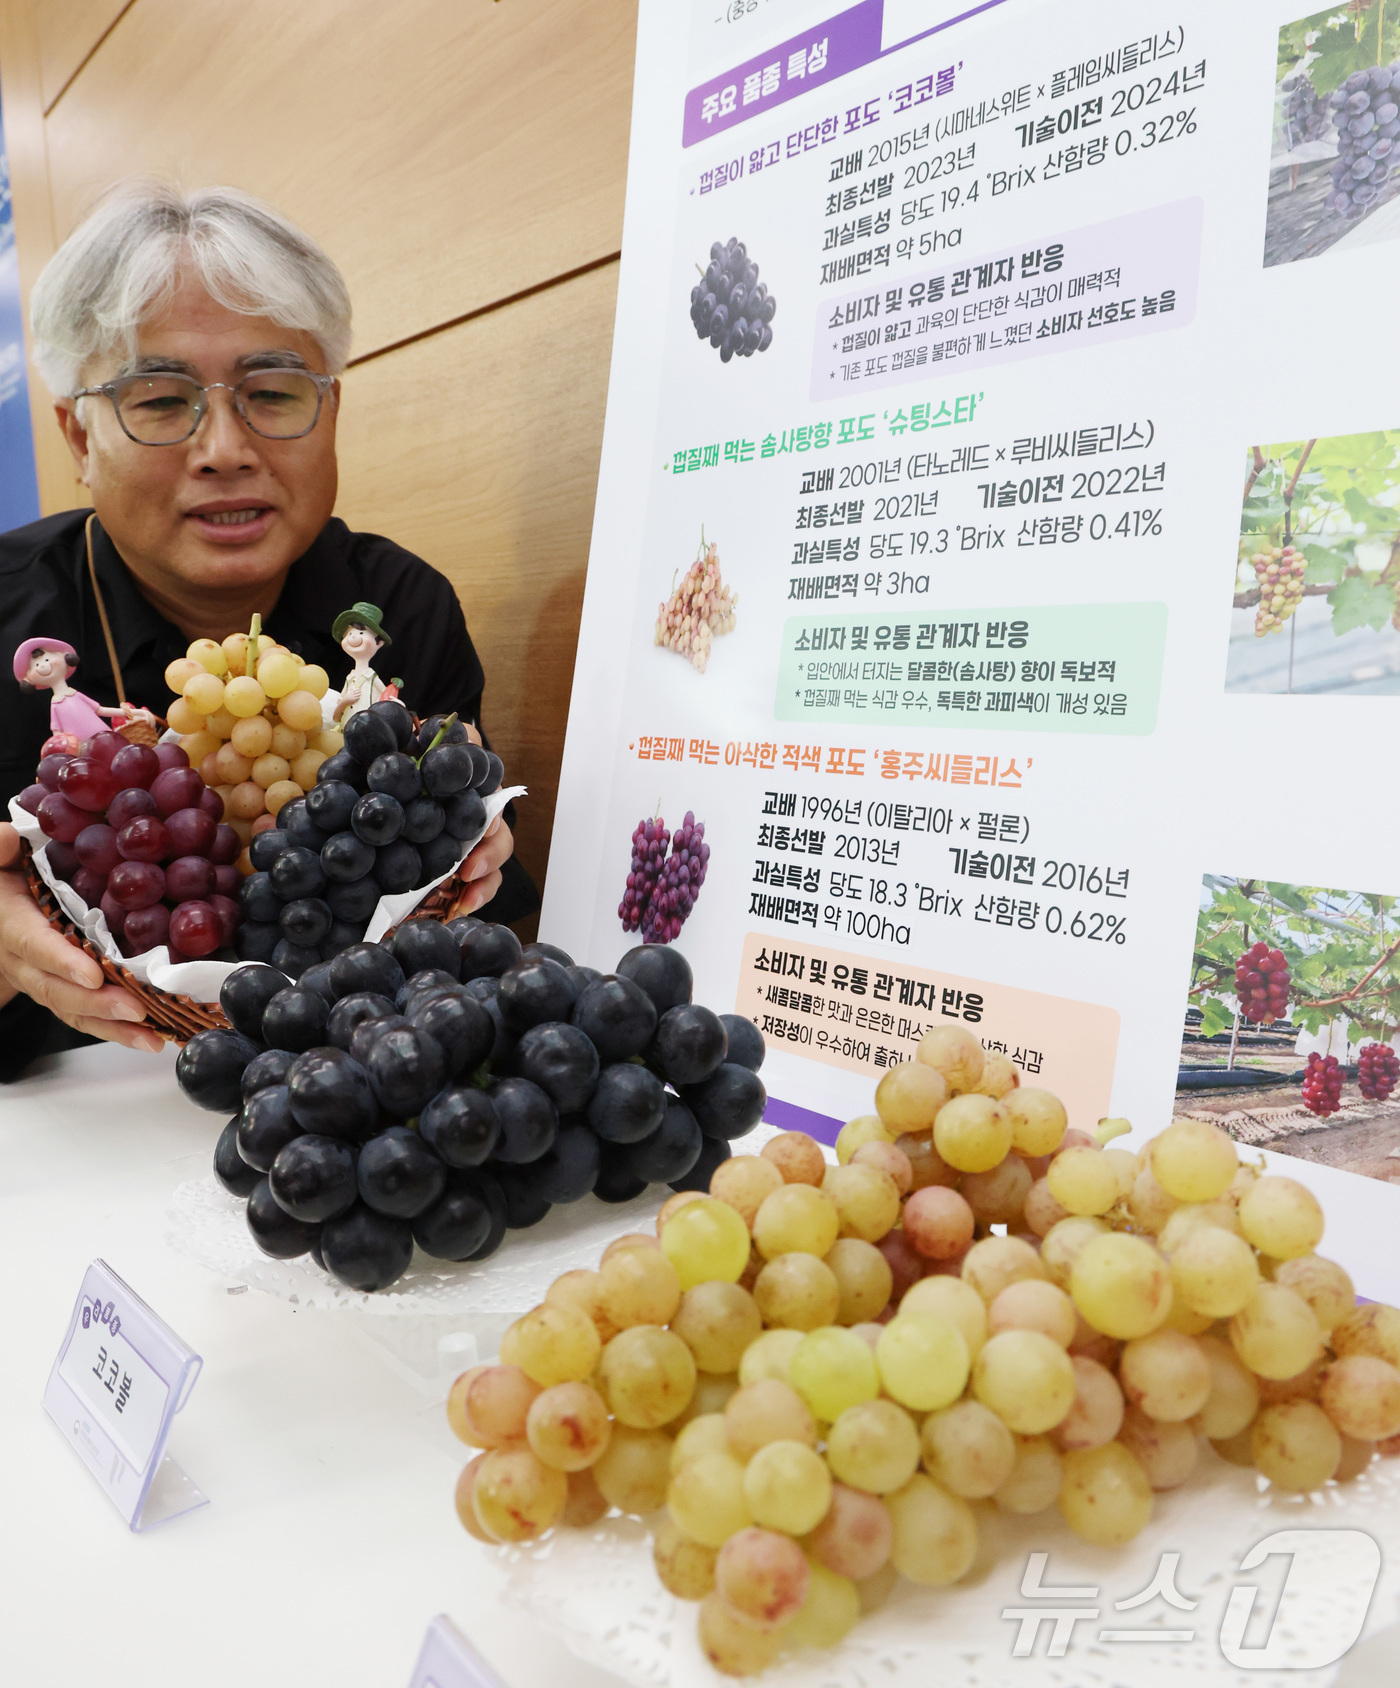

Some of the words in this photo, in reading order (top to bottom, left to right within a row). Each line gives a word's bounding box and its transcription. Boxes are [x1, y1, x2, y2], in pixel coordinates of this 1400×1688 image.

[700, 85, 738, 124] 주요
[742, 61, 781, 106] 품종
[786, 36, 830, 81] 특성
[827, 148, 864, 184] 교배
[867, 122, 931, 168] 2015년
[934, 83, 1032, 143] (시마네스위트
[1050, 24, 1185, 100] 플레임씨들리스)
[699, 155, 745, 196] 껍질이
[748, 140, 781, 175] 얇고
[785, 114, 840, 160] 단단한
[842, 96, 881, 136] 포도
[824, 171, 895, 218] 최종선발
[903, 141, 976, 190] 2023년
[1014, 95, 1104, 149] 기술이전
[1109, 58, 1207, 118] 2024년
[821, 207, 892, 252] 과실특성
[900, 193, 935, 227] 당도
[940, 179, 980, 213] 19.4
[1042, 135, 1110, 181] 산함량
[1114, 106, 1198, 157] 0.32%
[819, 242, 892, 286] 재배면적
[895, 236, 915, 261] 약
[918, 227, 963, 257] 5ha
[827, 293, 881, 330] 소비자
[884, 286, 904, 315] 및
[907, 275, 946, 309] 유통
[950, 255, 1016, 298] 관계자
[1020, 243, 1065, 280] 반응
[839, 361, 862, 382] 기존
[863, 354, 888, 378] 포도
[891, 345, 929, 372] 껍질을
[931, 331, 987, 363] 불편하게
[988, 321, 1033, 350] 느꼈던
[1035, 309, 1084, 340] 소비자
[1086, 297, 1137, 329] 선호도
[1140, 289, 1177, 318] 높음
[841, 326, 882, 354] 껍질이
[883, 319, 912, 344] 얇고
[914, 307, 959, 336] 과육의
[962, 294, 1011, 325] 단단한
[1013, 280, 1064, 310] 식감이
[1067, 266, 1122, 300] 매력적
[672, 442, 721, 475] 껍질째
[723, 438, 756, 464] 먹는
[760, 421, 834, 459] 솜사탕향
[836, 413, 876, 445] 포도
[798, 467, 836, 496] 교배
[837, 456, 902, 490] 2001년
[906, 443, 991, 481] (타노레드
[1010, 418, 1155, 466] 루비씨들리스)
[794, 498, 866, 530] 최종선발
[872, 489, 939, 522] 2021년
[976, 473, 1065, 510] 기술이전
[1070, 461, 1166, 500] 2022년
[790, 535, 861, 566] 과실특성
[869, 532, 905, 560] 당도
[909, 528, 950, 556] 19.3
[1016, 514, 1085, 548] 산함량
[1089, 507, 1163, 541] 0.41%
[786, 572, 860, 601] 재배면적
[863, 571, 883, 597] 약
[885, 570, 931, 596] 3ha
[793, 626, 847, 652] 소비자
[850, 625, 870, 651] 및
[872, 624, 912, 651] 유통
[915, 621, 981, 650] 관계자
[985, 620, 1030, 650] 반응
[806, 661, 860, 681] 입안에서
[861, 661, 904, 682] 터지는
[906, 659, 1017, 683] 달콤한(솜사탕)
[1020, 659, 1057, 683] 향이
[1059, 660, 1117, 683] 독보적
[803, 688, 842, 708] 껍질째
[843, 689, 869, 709] 먹는
[871, 689, 899, 710] 식감
[900, 690, 932, 713] 우수,
[936, 689, 983, 712] 독특한
[983, 690, 1051, 714] 과피색이
[1055, 692, 1089, 716] 개성
[1092, 692, 1128, 717] 있음
[637, 735, 686, 763] 껍질째
[688, 738, 721, 766] 먹는
[724, 741, 779, 770] 아삭한
[781, 743, 822, 774] 적색
[824, 746, 867, 777] 포도
[761, 790, 798, 818] 교배
[801, 795, 863, 826] 1996년
[866, 800, 954, 835] (이탈리아
[977, 811, 1030, 845] 펄론)
[756, 822, 827, 856] 최종선발
[833, 833, 901, 867] 2013년
[948, 846, 1037, 886] 기술이전
[1041, 859, 1130, 899] 2016년
[747, 891, 820, 929] 재배면적
[823, 904, 843, 932] 약
[846, 909, 912, 946] 100ha
[751, 859, 822, 894] 과실특성
[828, 870, 864, 901] 당도
[869, 877, 908, 908] 18.3
[973, 893, 1041, 931] 산함량
[1045, 905, 1128, 946] 0.62%
[753, 947, 806, 981] 소비자
[808, 957, 828, 987] 및
[830, 964, 869, 996] 유통
[872, 972, 937, 1012] 관계자
[940, 987, 985, 1024] 반응
[760, 1013, 814, 1046] 저장성이
[815, 1029, 872, 1063] 우수하여
[764, 984, 826, 1017] 새콤달콤한
[827, 999, 854, 1024] 맛과
[855, 1006, 896, 1036] 은은한
[1011, 1046, 1044, 1074] 식감
[92, 1346, 132, 1414] 코코볼
